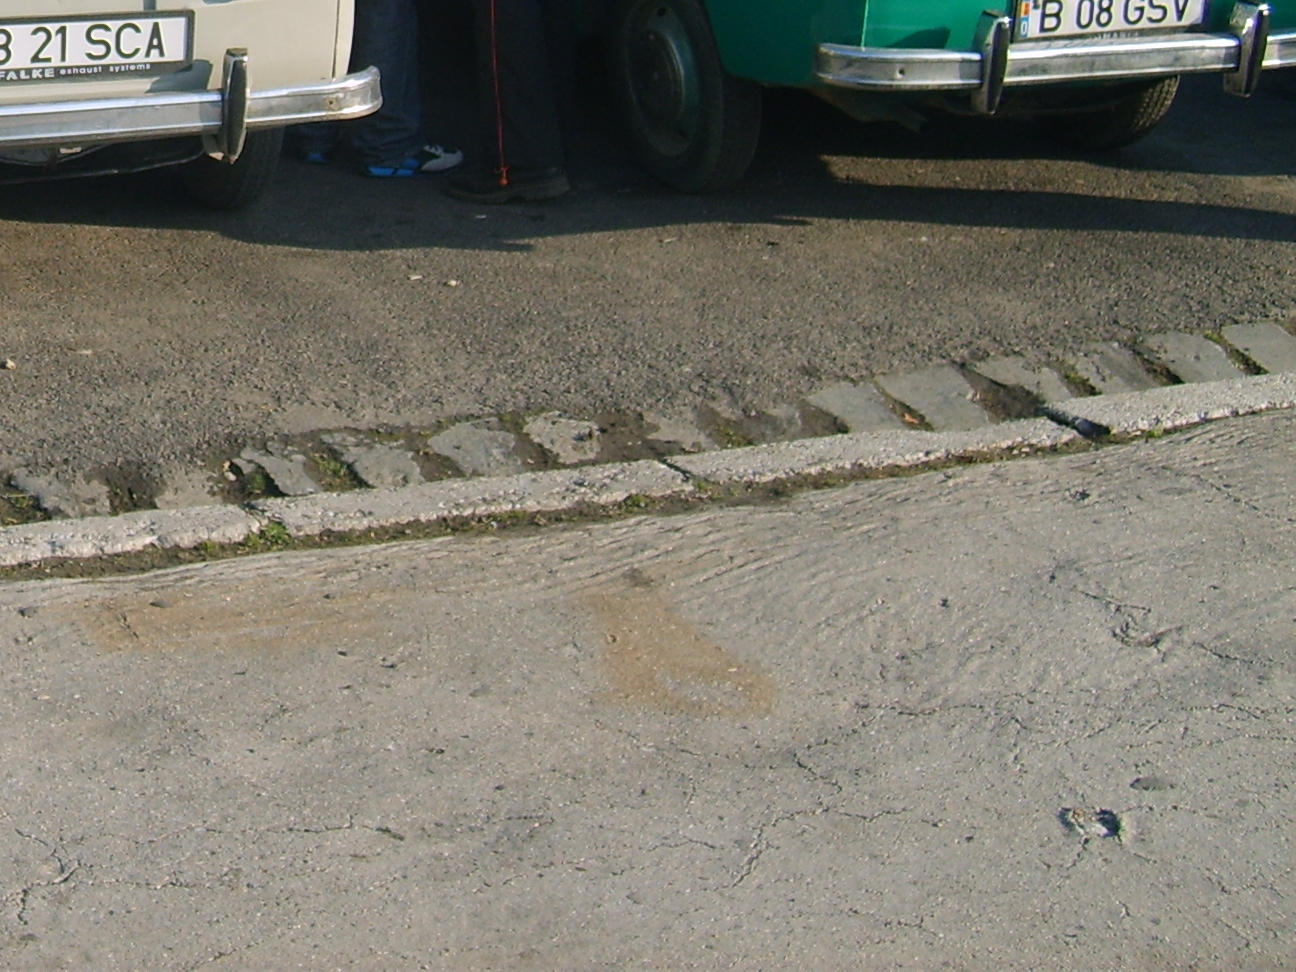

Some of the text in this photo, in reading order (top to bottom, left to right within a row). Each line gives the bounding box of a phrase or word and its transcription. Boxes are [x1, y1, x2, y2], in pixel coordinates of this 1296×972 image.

[29, 25, 67, 64] 21
[84, 21, 166, 61] SCA
[59, 65, 103, 76] exhaust
[109, 62, 151, 74] systems
